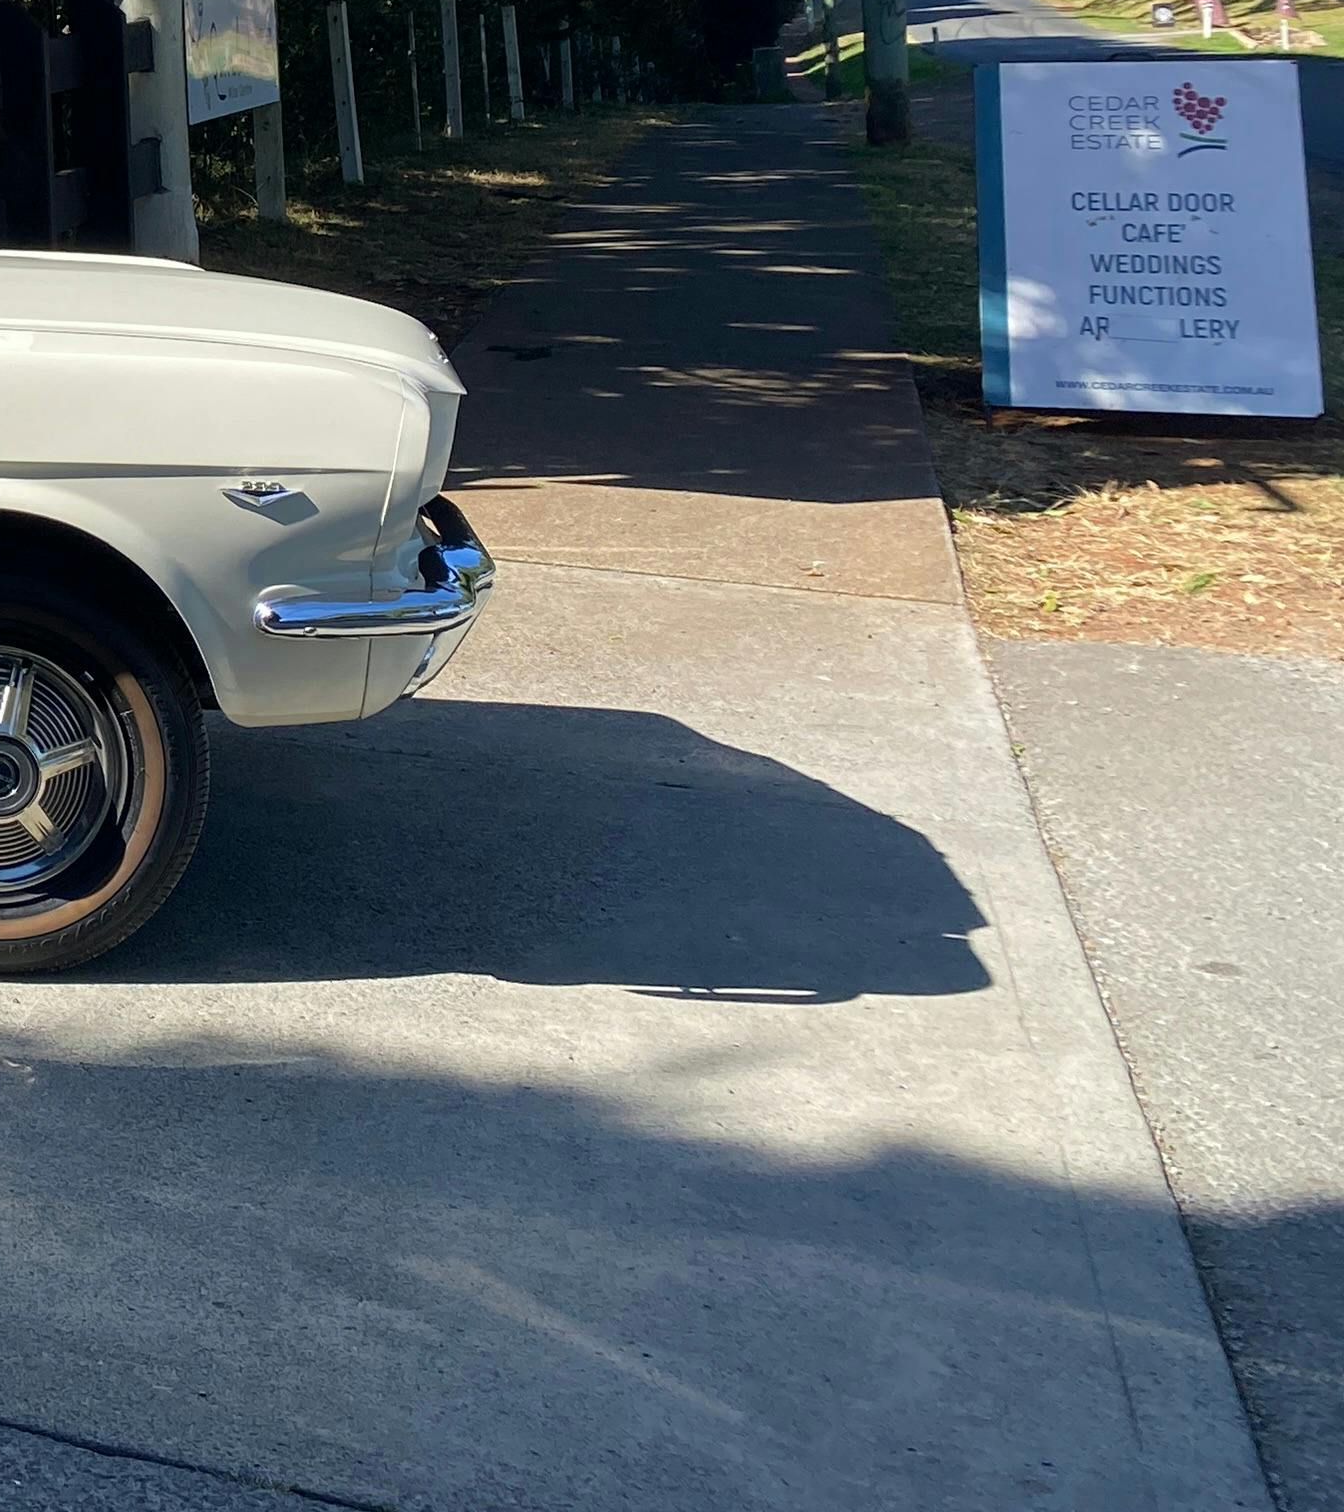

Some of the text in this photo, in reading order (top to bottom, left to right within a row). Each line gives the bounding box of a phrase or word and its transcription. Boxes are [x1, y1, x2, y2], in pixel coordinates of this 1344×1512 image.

[1068, 95, 1160, 111] CEDAR
[1069, 114, 1161, 131] CREEK
[1071, 134, 1161, 150] ESTATE
[1071, 192, 1236, 213] CELLAR DOOR
[1090, 254, 1222, 275] WEDDINGS
[1089, 285, 1228, 307] FUNCTIONS
[1055, 380, 1275, 396] WWW.CEDARCREEKESTATE.COM.AU
